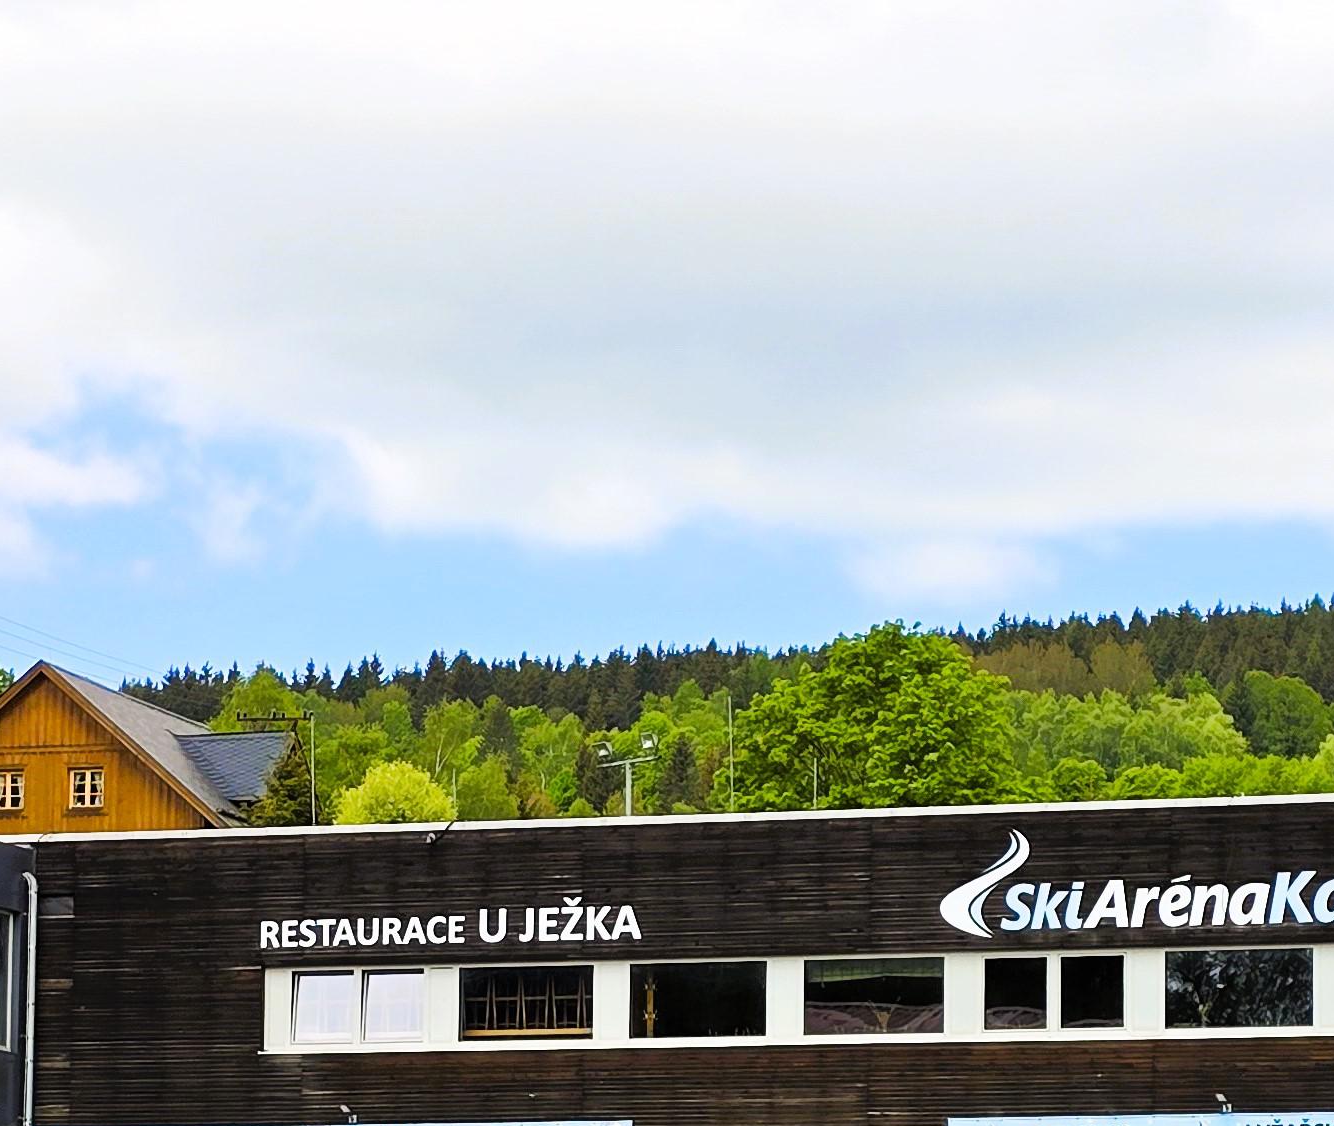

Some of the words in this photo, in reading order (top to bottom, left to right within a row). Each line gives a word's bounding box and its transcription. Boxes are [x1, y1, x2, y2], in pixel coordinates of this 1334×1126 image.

[260, 915, 465, 948] RESTAURACE
[479, 908, 507, 942] U
[518, 897, 641, 942] JEŽKA
